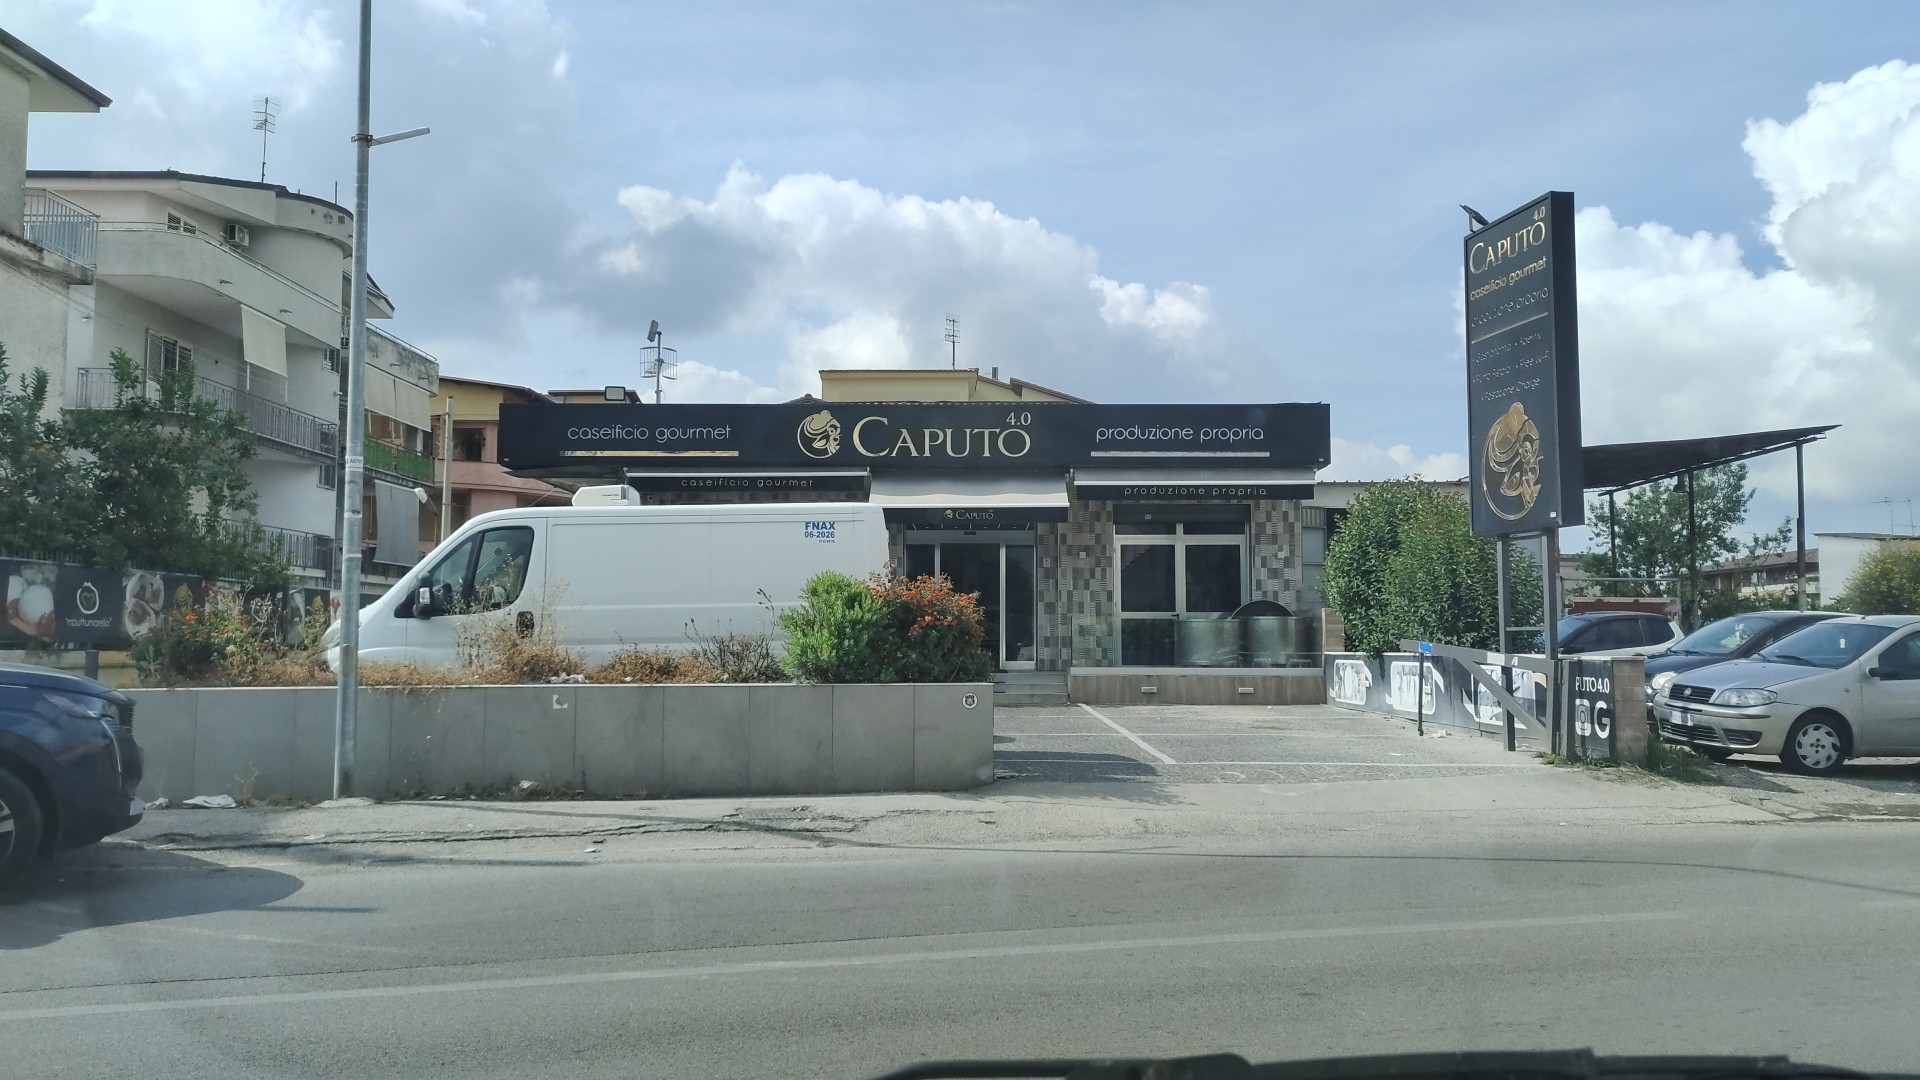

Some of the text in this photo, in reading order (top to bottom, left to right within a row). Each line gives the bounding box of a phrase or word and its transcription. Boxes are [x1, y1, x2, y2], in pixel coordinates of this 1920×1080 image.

[1533, 206, 1546, 221] 4.0
[1469, 221, 1546, 275] CAPUTO
[1470, 255, 1547, 301] caseificio gourmet
[1005, 411, 1032, 426] 4.0
[568, 424, 732, 444] caseificio gourmet
[852, 416, 1031, 458] CAPUTO
[1096, 424, 1264, 444] produzione propria
[681, 477, 814, 488] caseificio gourmet
[1124, 486, 1267, 497] produzione propria
[955, 509, 994, 520] CAPUTO
[804, 521, 836, 531] FNAX
[804, 530, 836, 539] 06-2026
